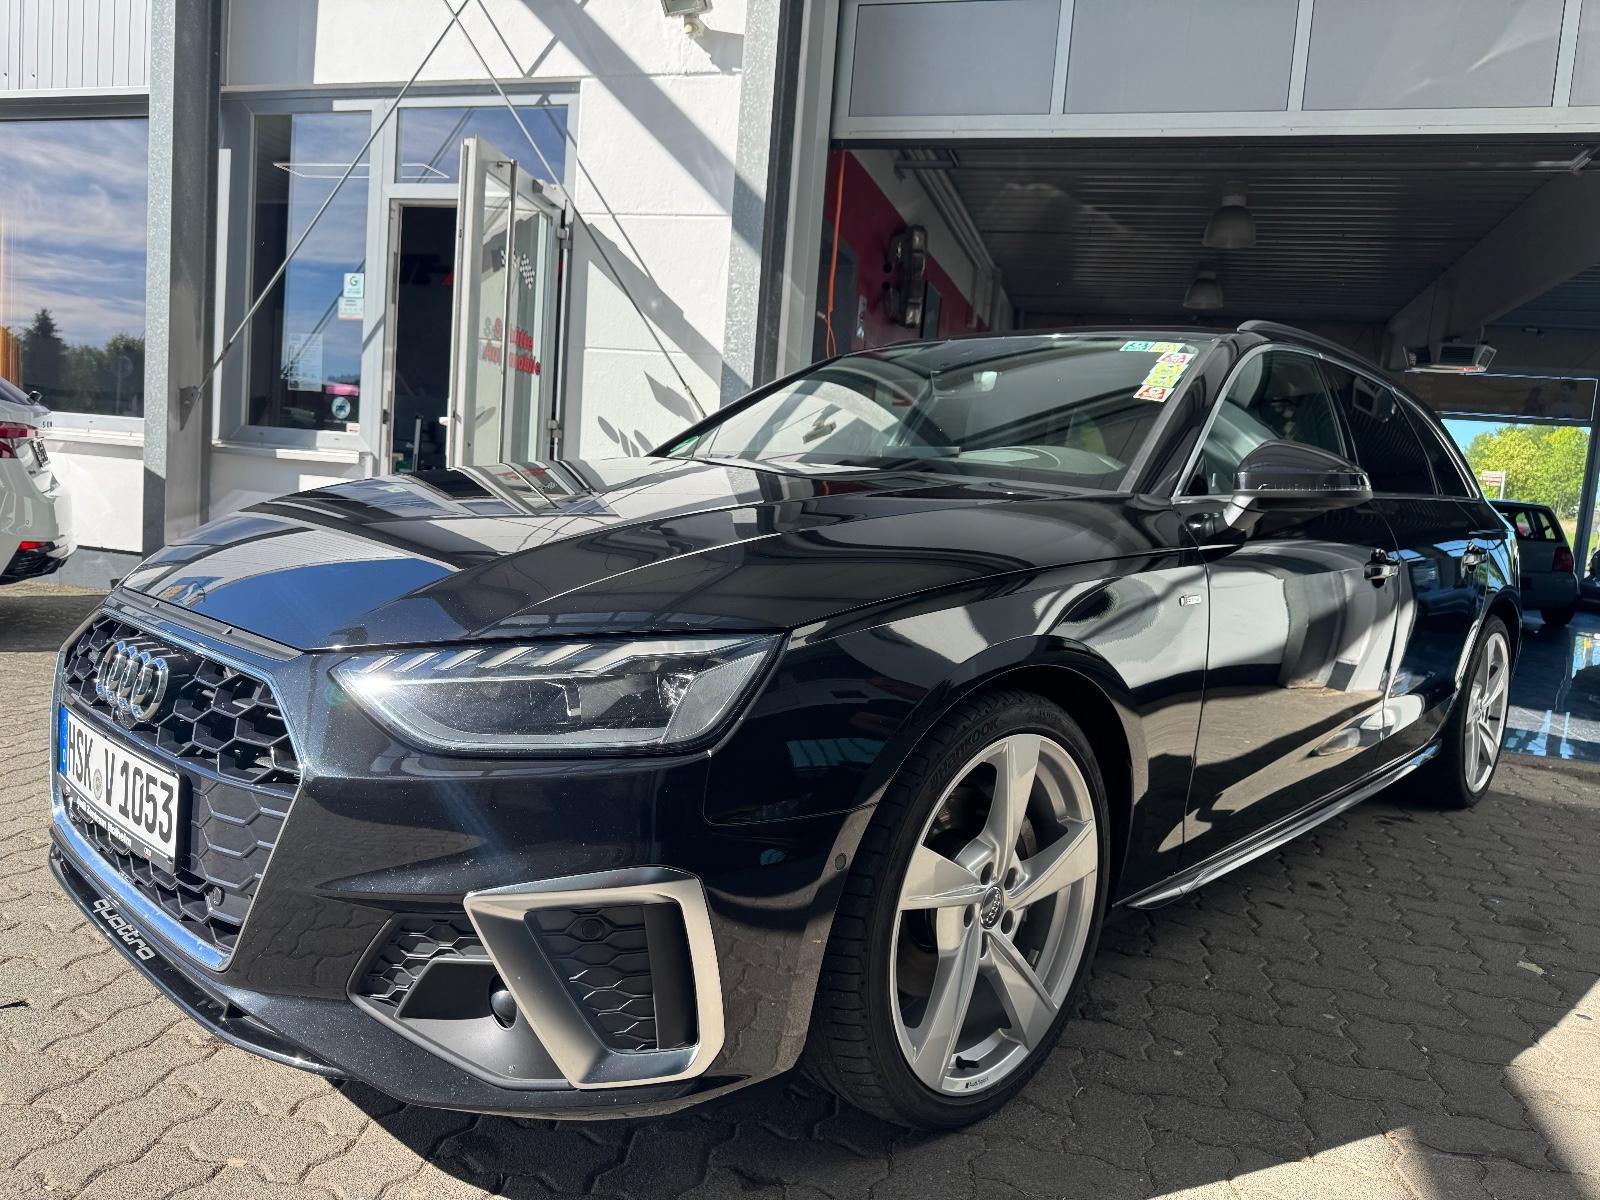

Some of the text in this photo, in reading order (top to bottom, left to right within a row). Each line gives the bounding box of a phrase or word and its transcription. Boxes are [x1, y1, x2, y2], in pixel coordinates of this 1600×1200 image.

[68, 721, 174, 844] HSK V 1053
[93, 898, 155, 961] quattro
